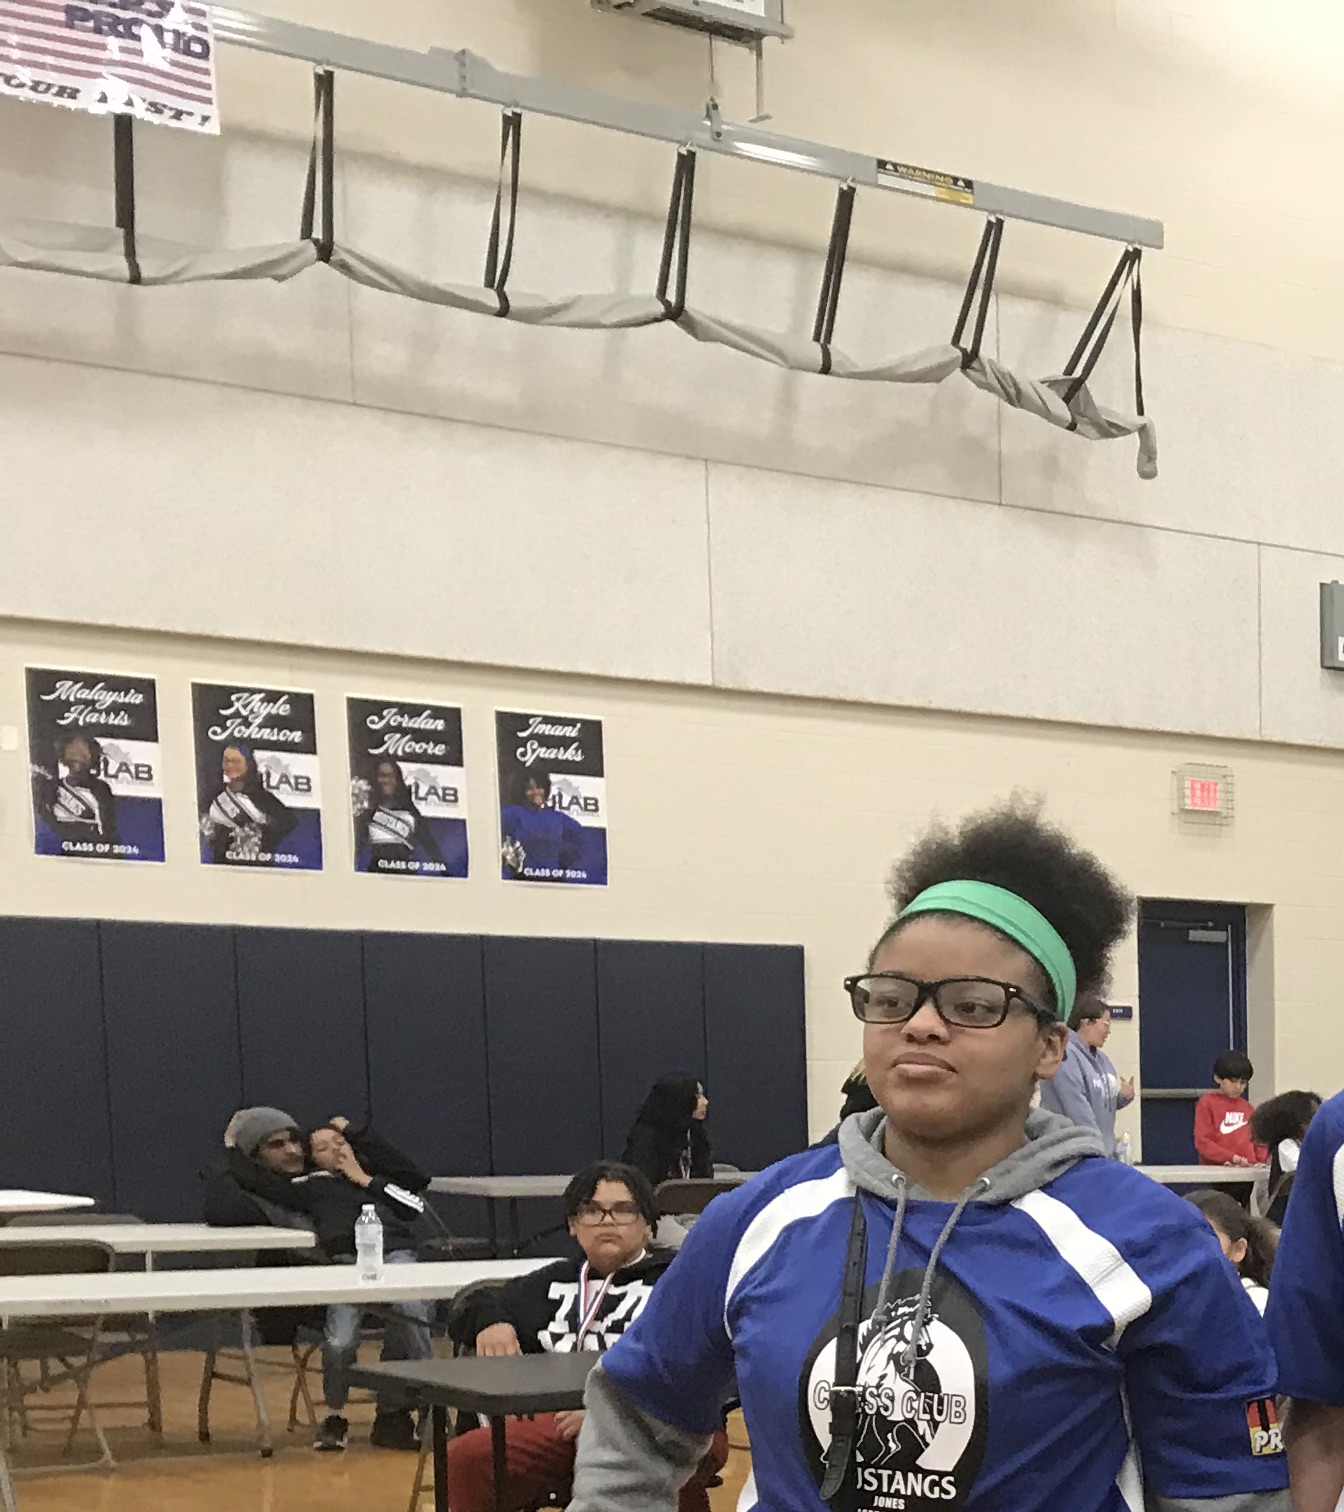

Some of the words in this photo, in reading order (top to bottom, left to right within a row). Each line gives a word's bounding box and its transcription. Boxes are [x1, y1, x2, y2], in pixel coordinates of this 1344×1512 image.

[40, 680, 144, 709] Malaysia
[56, 704, 131, 726] Harris
[218, 692, 291, 722] Khyle
[208, 718, 303, 743] Johnson
[366, 708, 445, 731] Jordan
[517, 717, 581, 738] Imani
[367, 732, 447, 756] Moore
[516, 740, 585, 767] Sparks
[62, 841, 94, 853] CLASS
[96, 843, 110, 853] OF
[225, 850, 256, 862] CLASS
[258, 852, 272, 862] OF
[377, 858, 406, 869] CLASS
[407, 860, 420, 870] OF
[524, 867, 550, 877] CLASS
[552, 868, 564, 877] OF
[1225, 1111, 1245, 1124] NIKE
[813, 1380, 895, 1416] CSS
[901, 1390, 967, 1424] CLUB
[857, 1468, 957, 1500] STANGS
[873, 1496, 905, 1510] JONES
